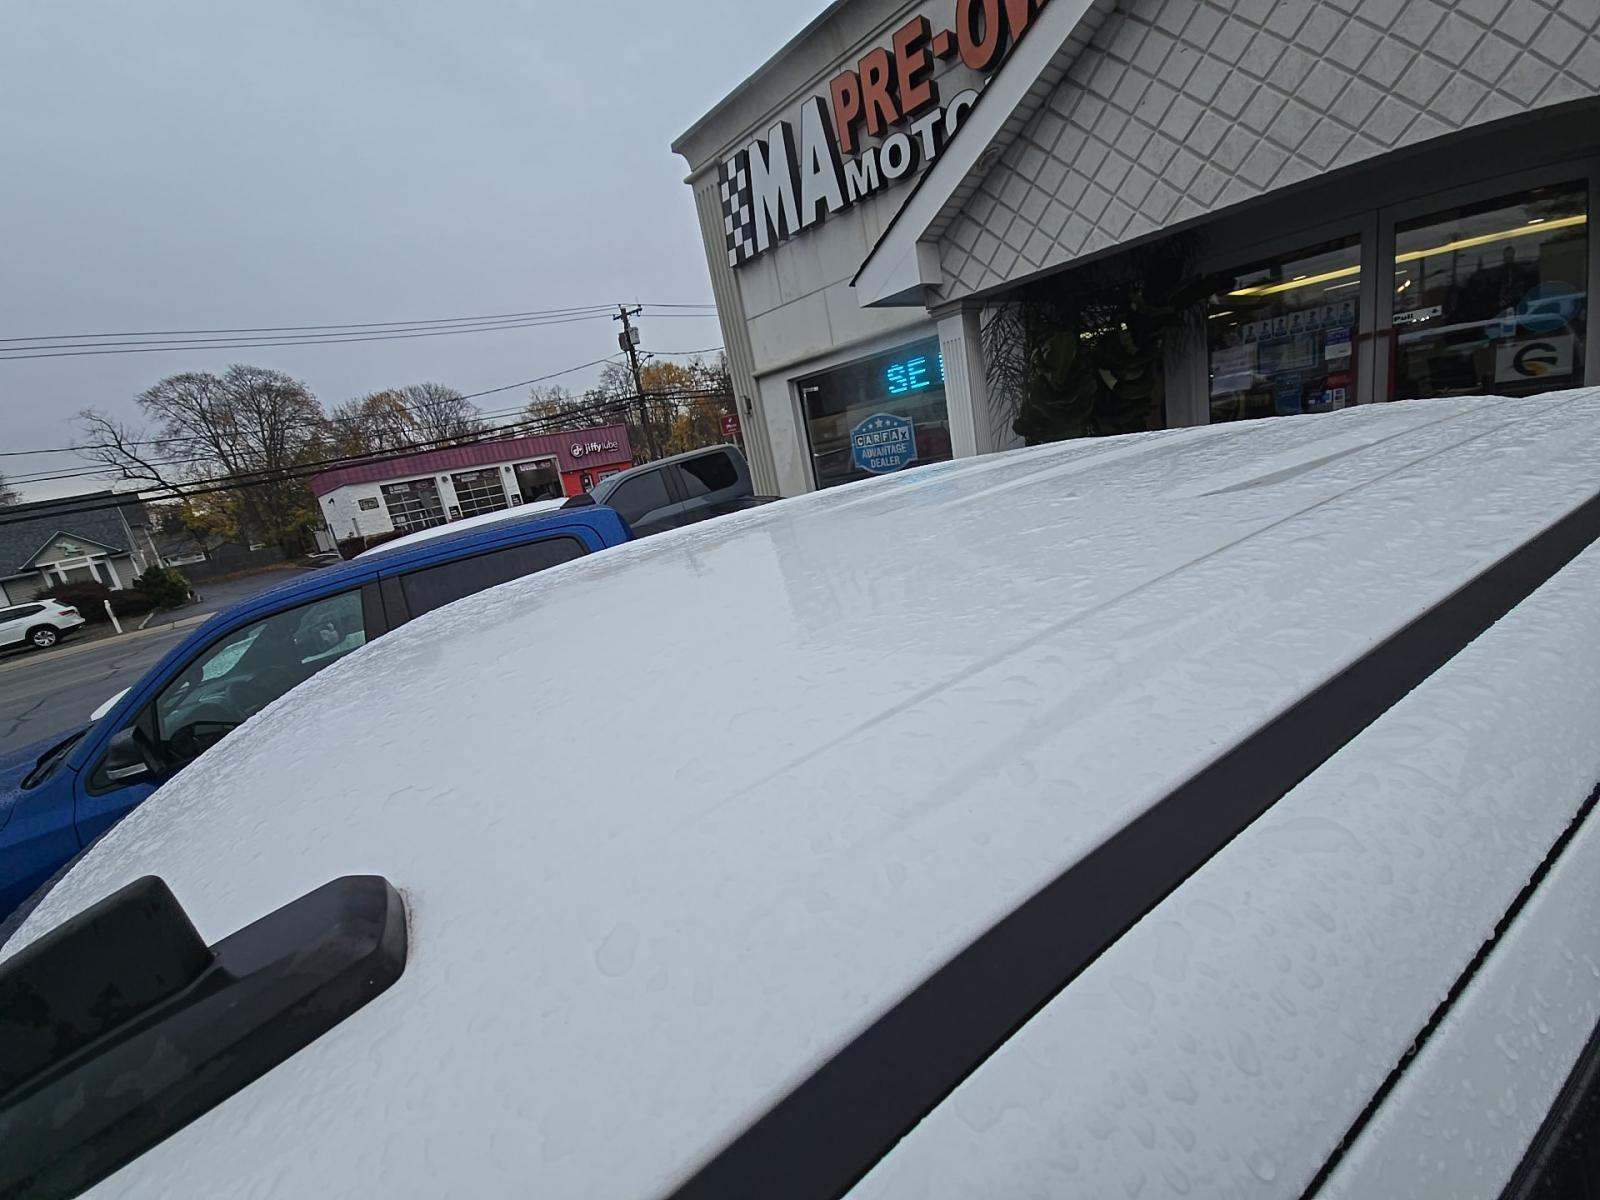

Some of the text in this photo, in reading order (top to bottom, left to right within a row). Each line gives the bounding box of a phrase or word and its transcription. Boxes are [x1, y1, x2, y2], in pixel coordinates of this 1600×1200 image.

[747, 96, 844, 253] MA
[856, 427, 910, 446] CARFAX
[862, 443, 907, 459] ADVANTAGE
[870, 455, 901, 468] DEALER
